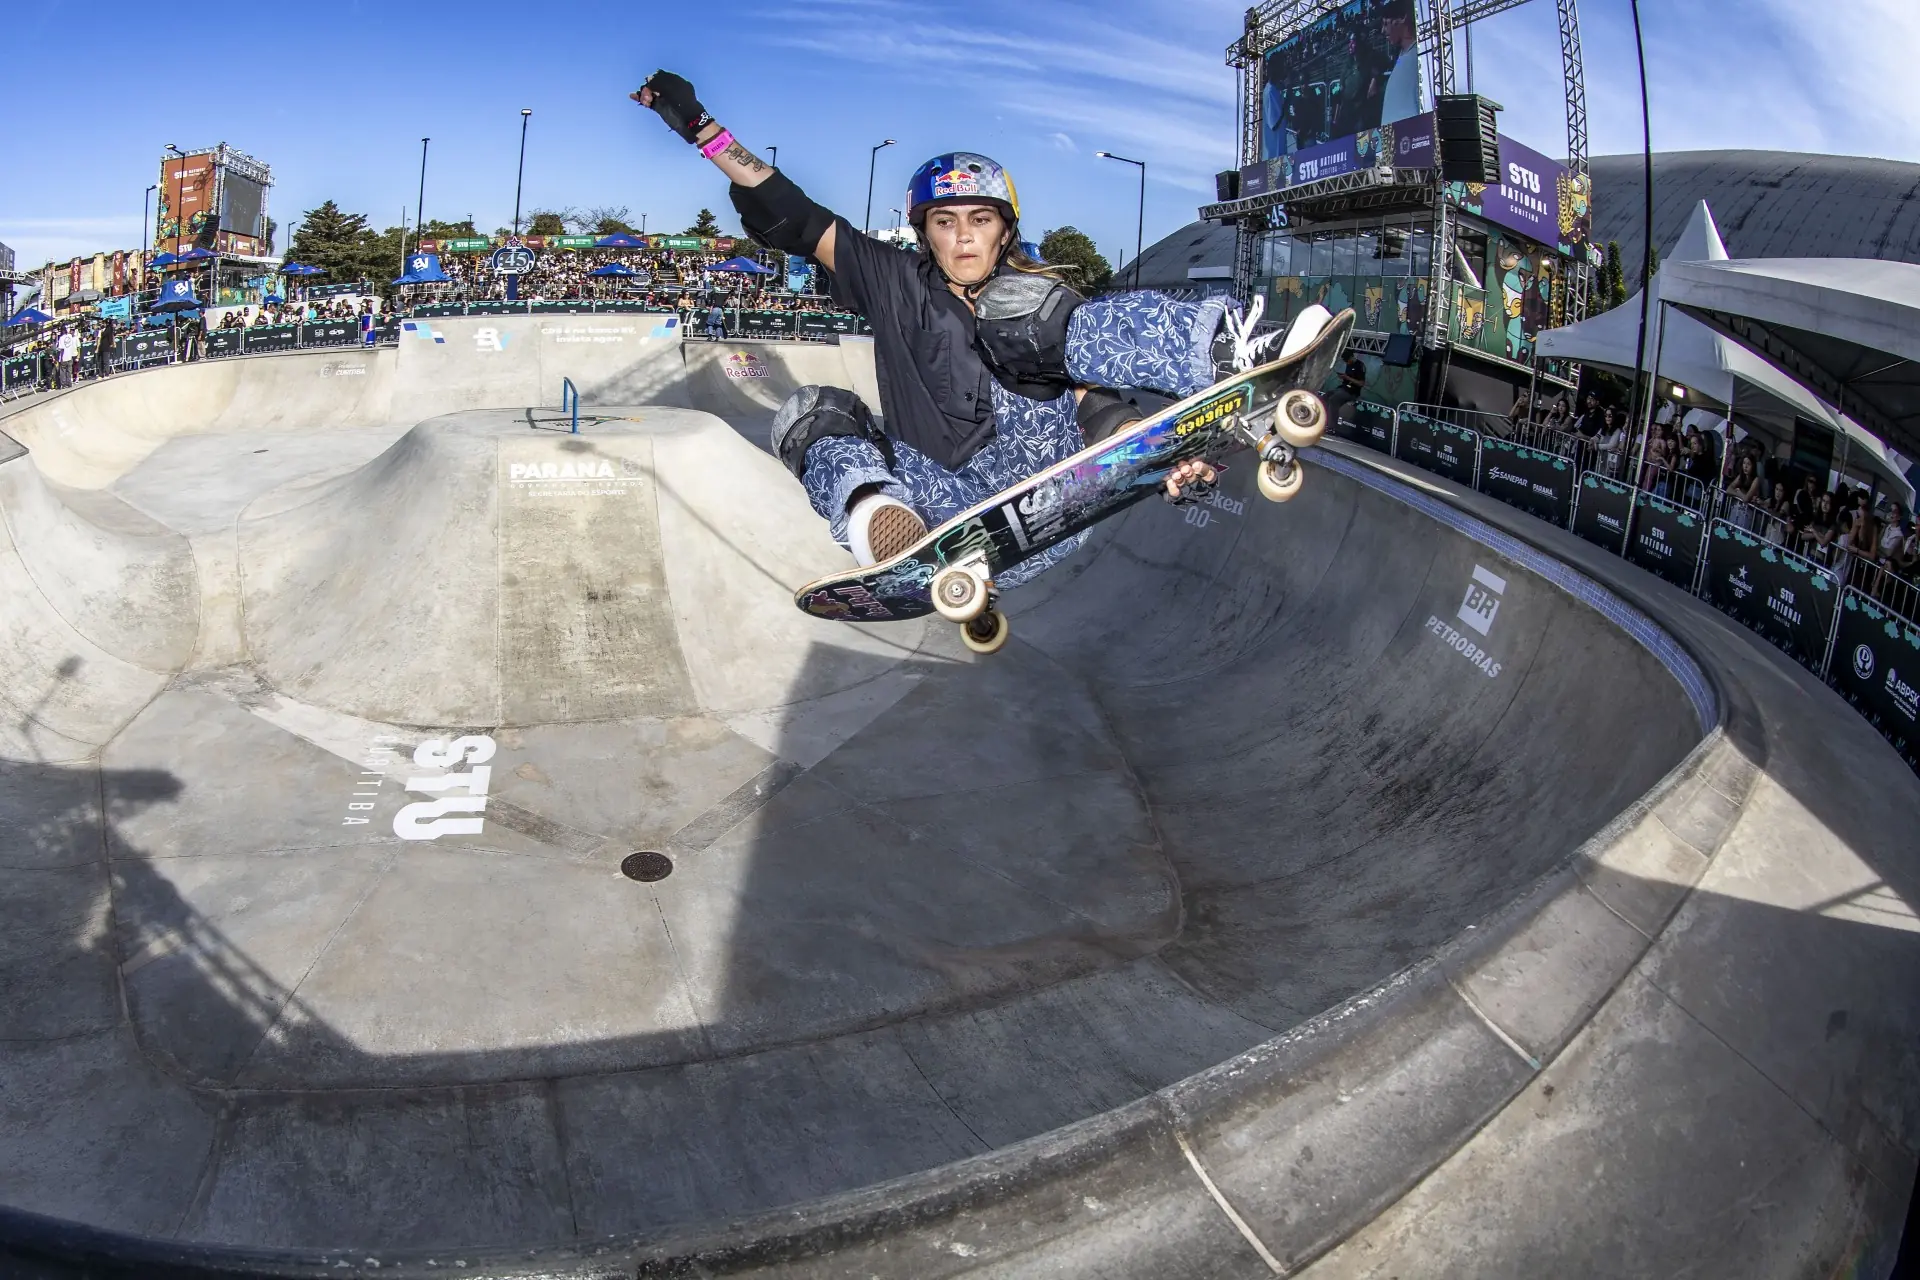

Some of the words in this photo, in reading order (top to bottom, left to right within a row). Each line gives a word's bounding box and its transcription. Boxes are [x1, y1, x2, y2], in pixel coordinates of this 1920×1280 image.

[1299, 159, 1319, 181] STU
[1320, 151, 1347, 167] NATIONAL
[1508, 162, 1541, 194] STU
[935, 184, 956, 196] Red
[955, 182, 978, 194] Bull
[1500, 183, 1548, 216] NATIONAL
[1510, 204, 1539, 223] CURITIBA
[335, 368, 366, 376] CURITIBA
[726, 367, 749, 378] Red
[748, 366, 769, 378] Bull
[510, 459, 616, 479] PARANÁ
[1499, 471, 1528, 487] SANEPAR
[1532, 483, 1553, 496] PARANÁ
[1203, 489, 1245, 516] eken
[1596, 512, 1620, 527] PARANÁ
[1639, 534, 1673, 557] NATIONAL
[1651, 526, 1665, 540] STU
[1728, 573, 1753, 594] Heineken
[1780, 587, 1795, 604] STU
[1465, 587, 1497, 620] BR
[1767, 595, 1801, 625] NATIONAL
[1424, 615, 1502, 678] PETROBRAS
[1895, 679, 1920, 708] ABPSK
[341, 735, 398, 826] CURITIBA
[393, 734, 497, 841] STU
